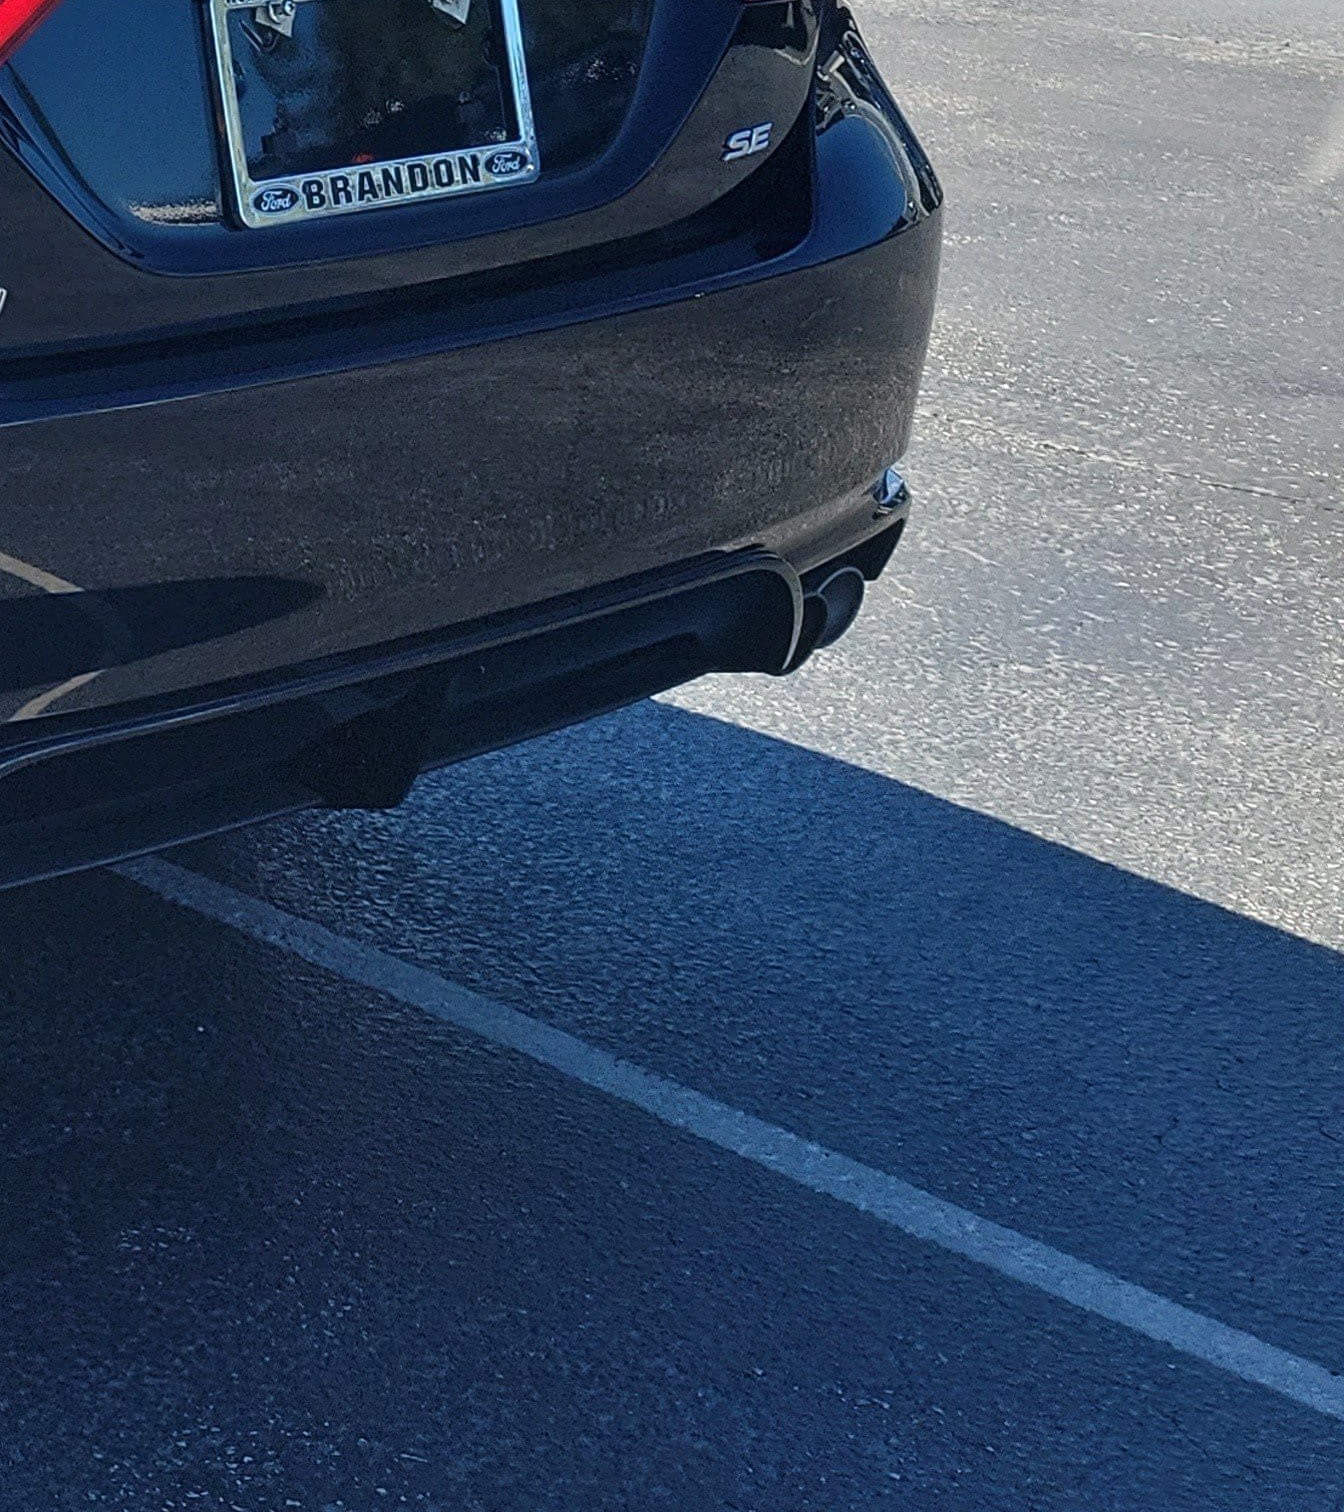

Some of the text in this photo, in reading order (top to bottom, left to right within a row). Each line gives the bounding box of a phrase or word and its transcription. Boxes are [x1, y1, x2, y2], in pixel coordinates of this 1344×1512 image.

[722, 122, 773, 162] SE
[260, 152, 521, 211] Ford BRANDON Ford
